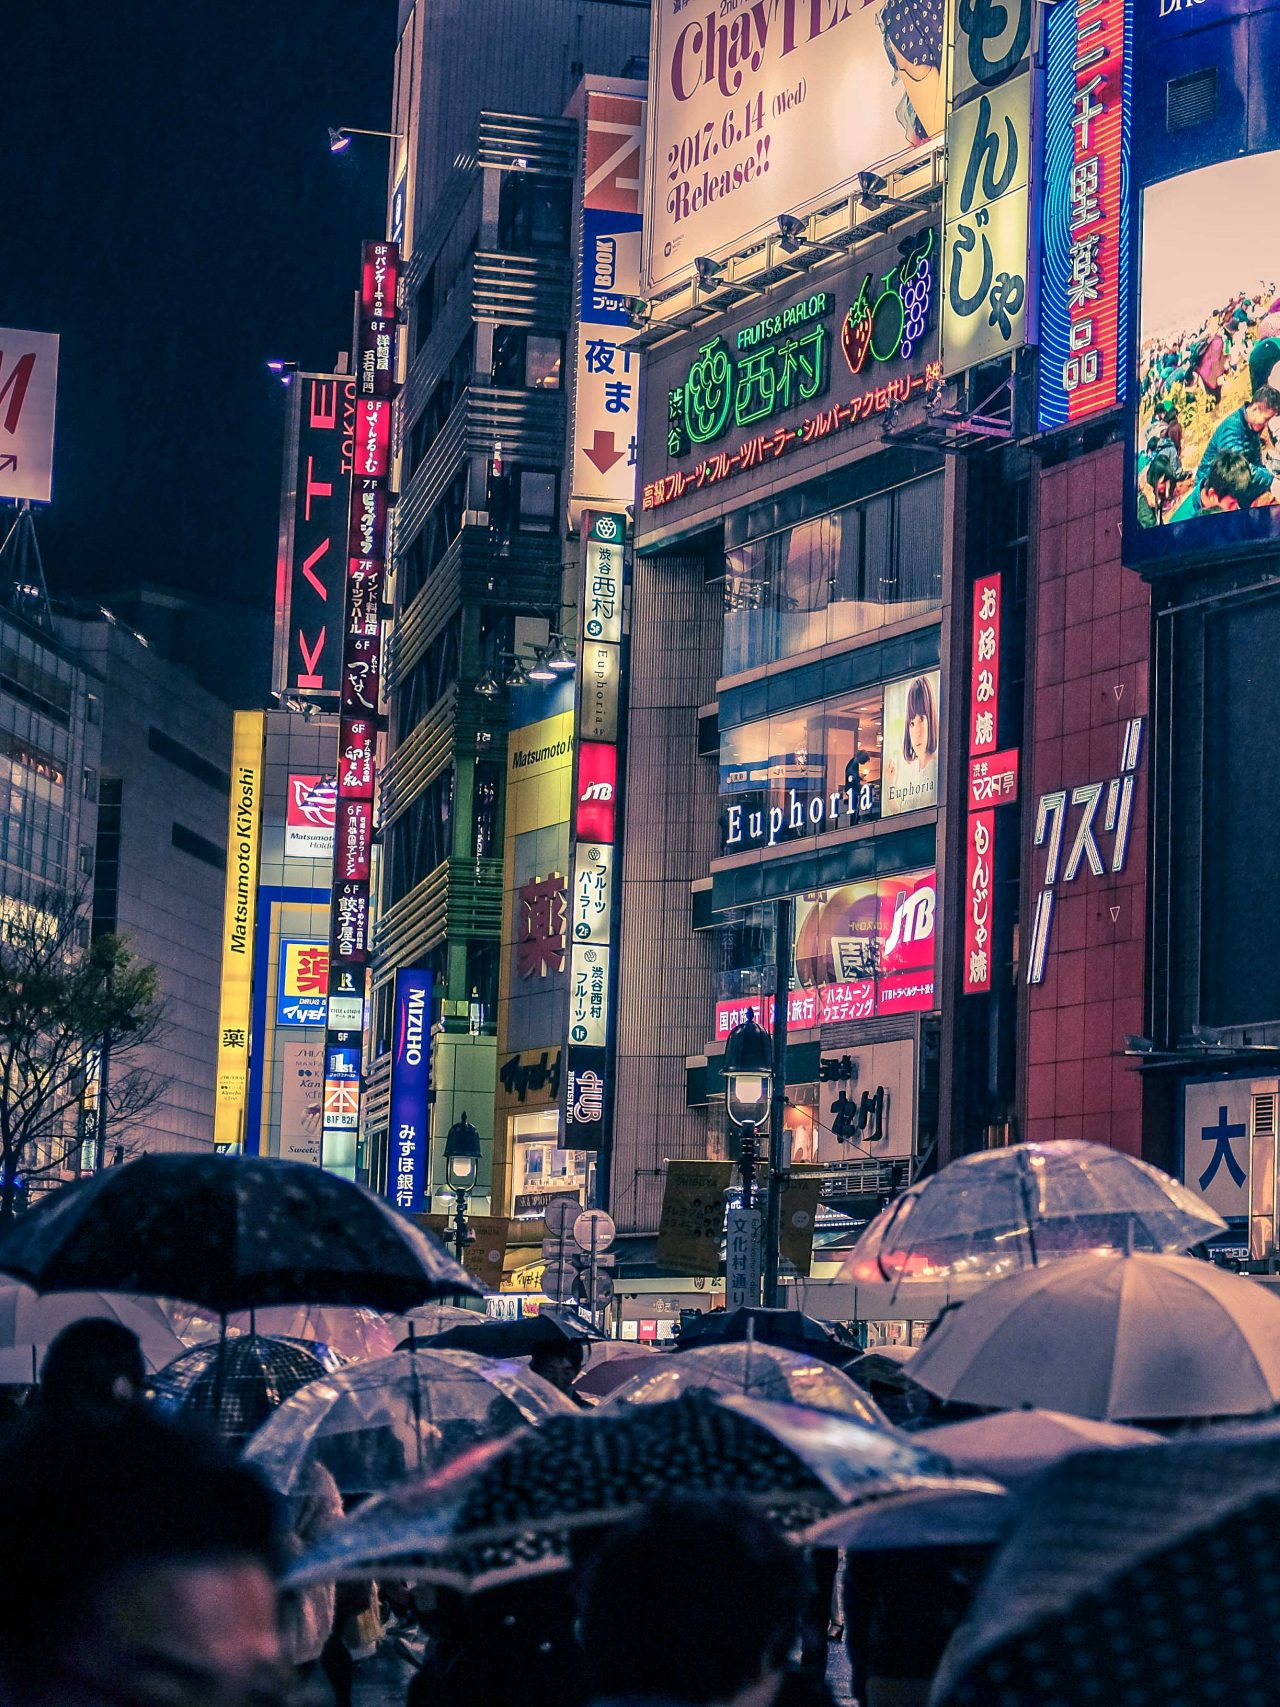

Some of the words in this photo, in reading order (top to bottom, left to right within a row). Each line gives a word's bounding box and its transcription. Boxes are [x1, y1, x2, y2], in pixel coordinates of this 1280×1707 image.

[667, 90, 765, 182] 2017.6.14
[772, 77, 807, 119] (Wed)
[666, 134, 771, 224] Release!!
[949, 0, 1032, 341] もんじゃ
[374, 246, 388, 255] 8F
[594, 241, 614, 287] BOOK
[373, 257, 388, 317] パンケーキの店
[370, 322, 386, 331] 8F
[362, 350, 375, 394] 五右衛門
[736, 325, 824, 427] 西村
[367, 401, 382, 411] 8F
[667, 387, 684, 457] 渋谷
[362, 479, 378, 490] 7F
[359, 560, 373, 571] 7F
[350, 572, 364, 635] タージマハール
[364, 572, 378, 636] インド料理店
[355, 640, 371, 651] 6F
[975, 586, 996, 745] お好み焼
[595, 649, 609, 724] Euphoria
[351, 724, 366, 734] 6F
[513, 740, 566, 770] Matsumoto
[347, 805, 363, 816] 6F
[580, 782, 613, 801] JTB
[889, 777, 934, 802] Euphoria
[726, 783, 873, 846] Euphoria
[230, 842, 251, 955] Matsumoto
[343, 884, 359, 894] 6F
[578, 871, 592, 919] パーラー
[594, 864, 607, 914] フルーツ
[968, 820, 989, 985] もんじゃ焼
[884, 886, 936, 956] JTB
[574, 972, 588, 1022] フルーツ
[589, 965, 604, 1019] 渋谷西村
[823, 1001, 873, 1022] ウエディング
[826, 985, 871, 1004] ハネムーン
[223, 1028, 245, 1049] 薬
[337, 1032, 349, 1042] 5F
[406, 988, 425, 1065] MIZUHO
[567, 1070, 575, 1106] BRITISH
[326, 1115, 340, 1124] B1F
[341, 1115, 355, 1124] B2F
[396, 1124, 417, 1207] みずほ銀行
[732, 1218, 748, 1307] 文化村通り
